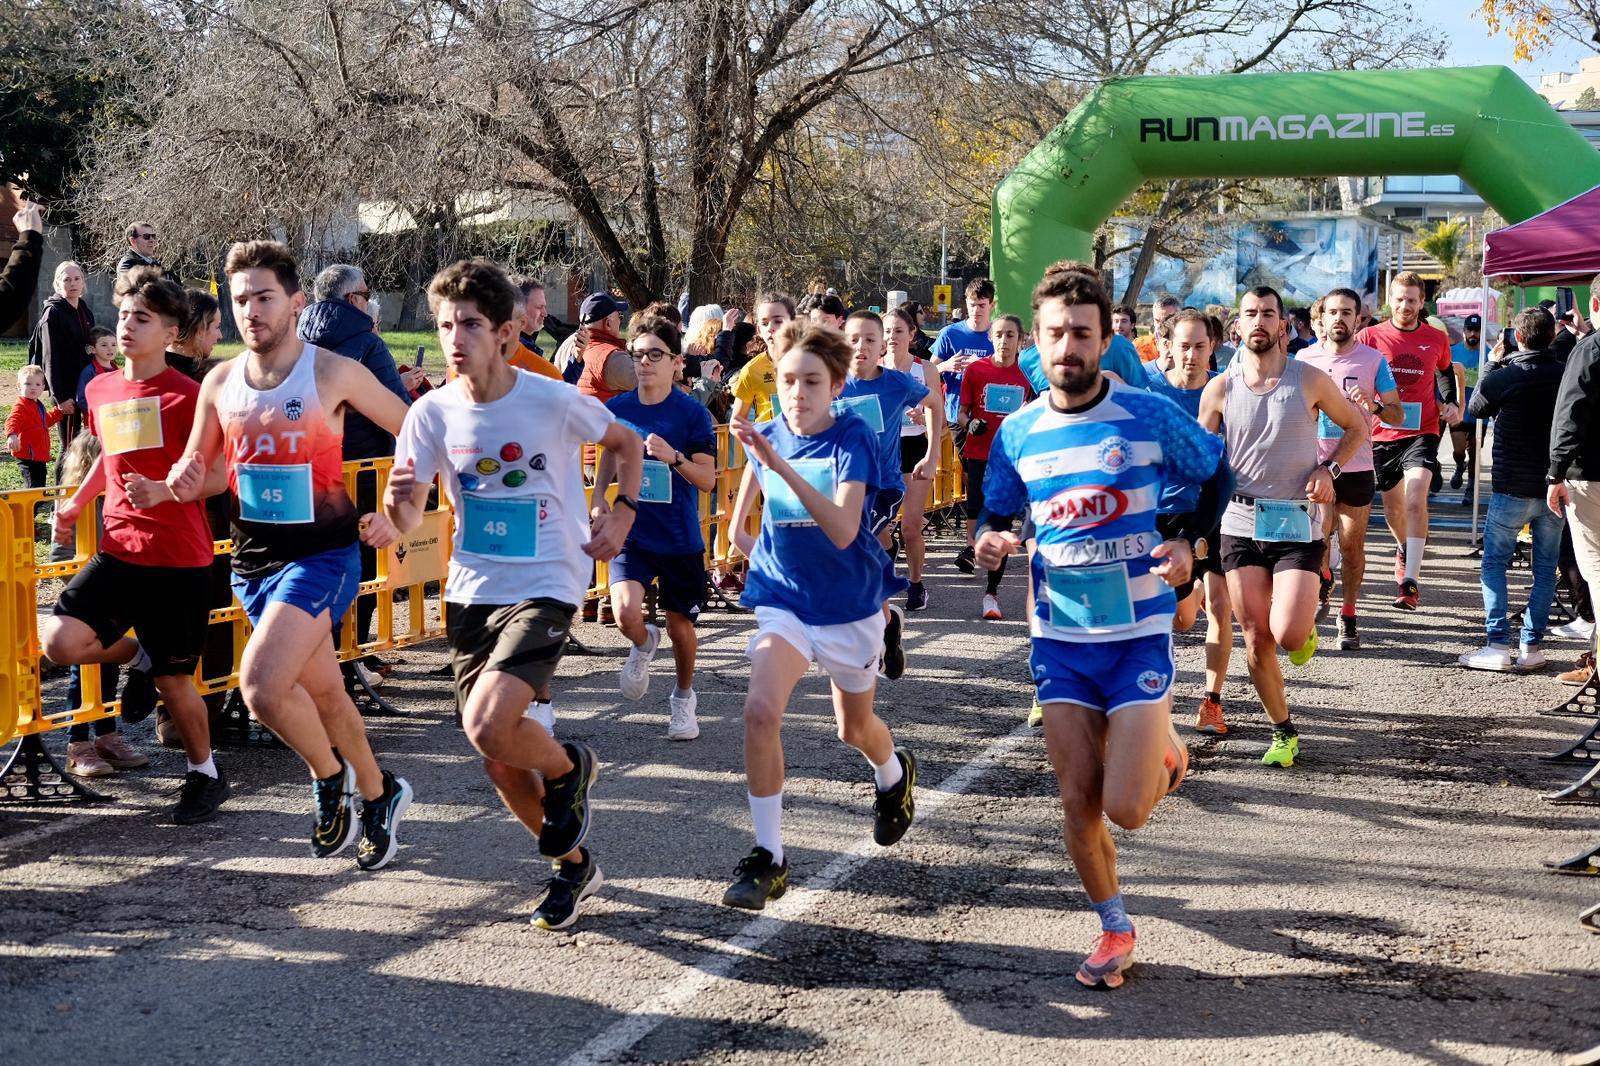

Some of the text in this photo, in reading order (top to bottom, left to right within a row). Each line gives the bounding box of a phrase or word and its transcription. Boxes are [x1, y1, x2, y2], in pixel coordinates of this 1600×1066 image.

[261, 488, 283, 503] 45
[778, 508, 811, 518] HECTO
[1050, 495, 1109, 520] DANI
[483, 520, 508, 537] 48
[1279, 517, 1289, 528] 7
[1080, 592, 1092, 609] 1
